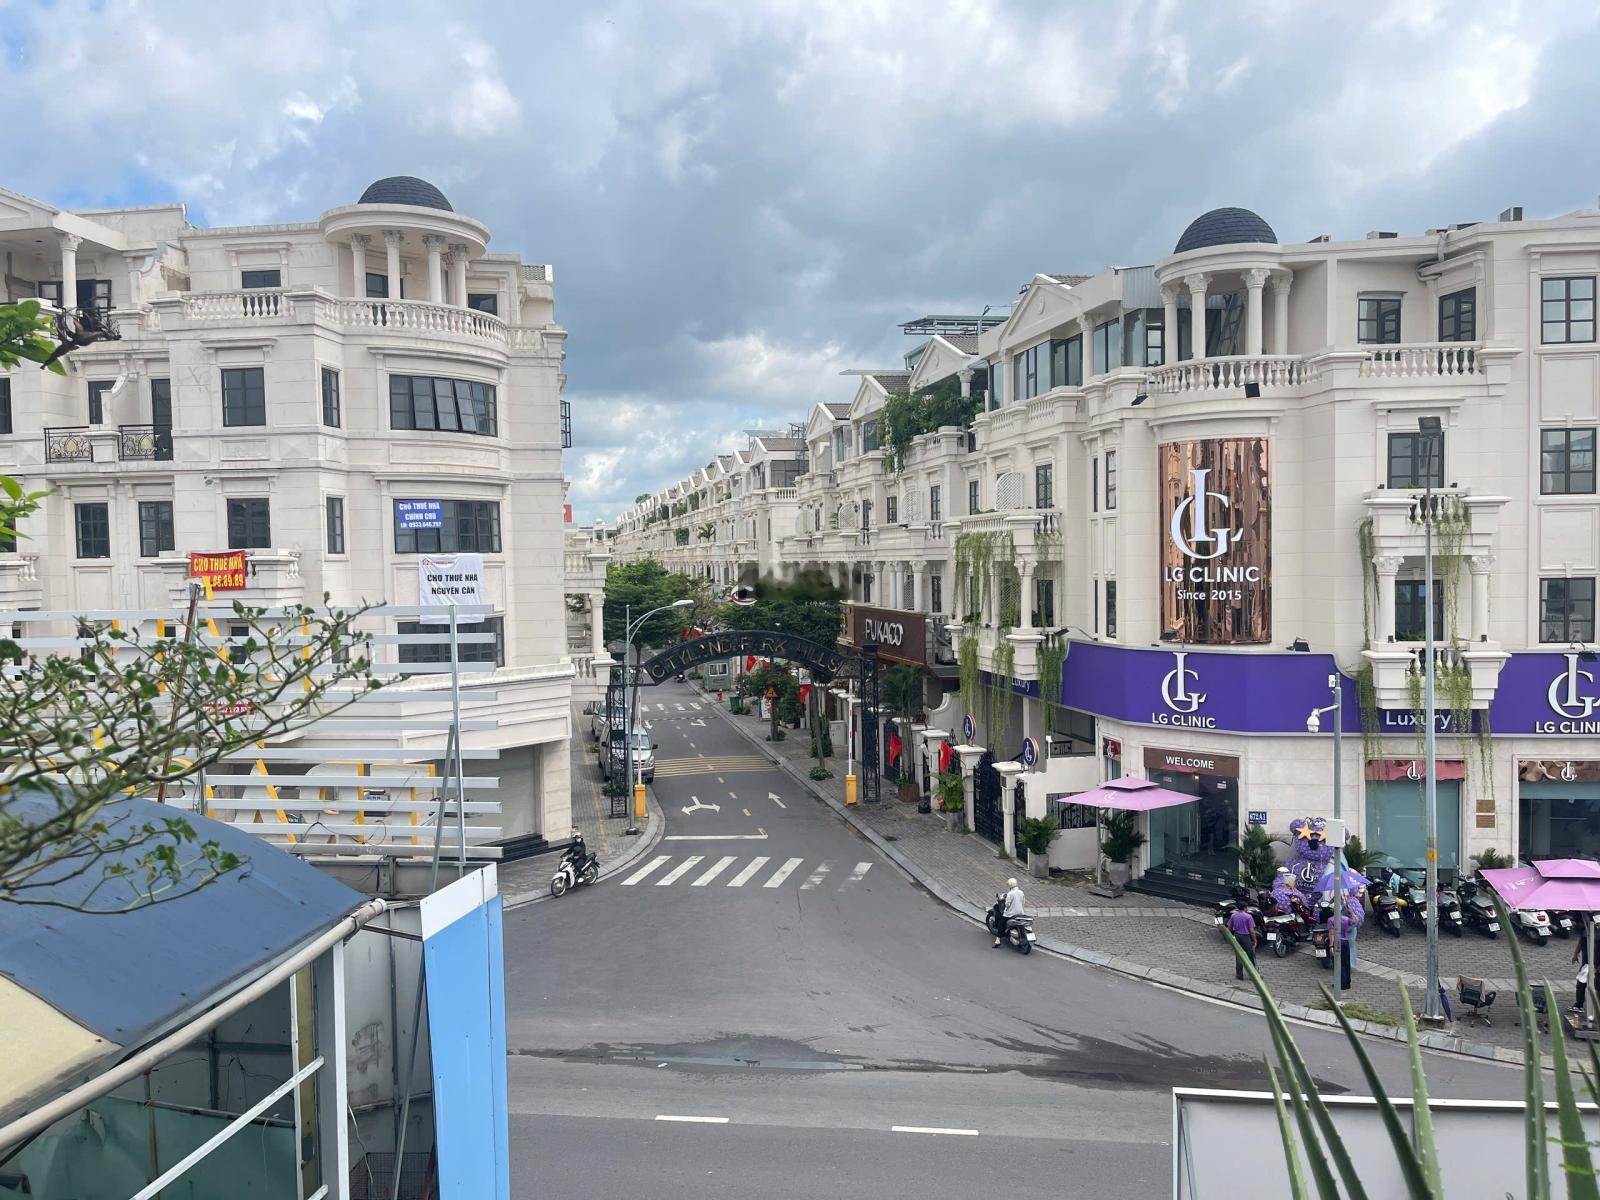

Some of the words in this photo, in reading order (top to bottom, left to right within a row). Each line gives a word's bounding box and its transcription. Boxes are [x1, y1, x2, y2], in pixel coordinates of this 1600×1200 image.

[194, 558, 208, 571] CHO
[427, 574, 442, 582] CHO
[1165, 567, 1184, 582] LG
[1189, 566, 1260, 583] CLINIC
[1177, 590, 1206, 600] Since
[1211, 590, 1242, 601] 2015
[1152, 712, 1168, 724] LG
[1172, 714, 1216, 729] CLINIC
[1535, 721, 1555, 733] LG
[1560, 721, 1600, 734] CLINI
[1166, 755, 1215, 769] WELCOME
